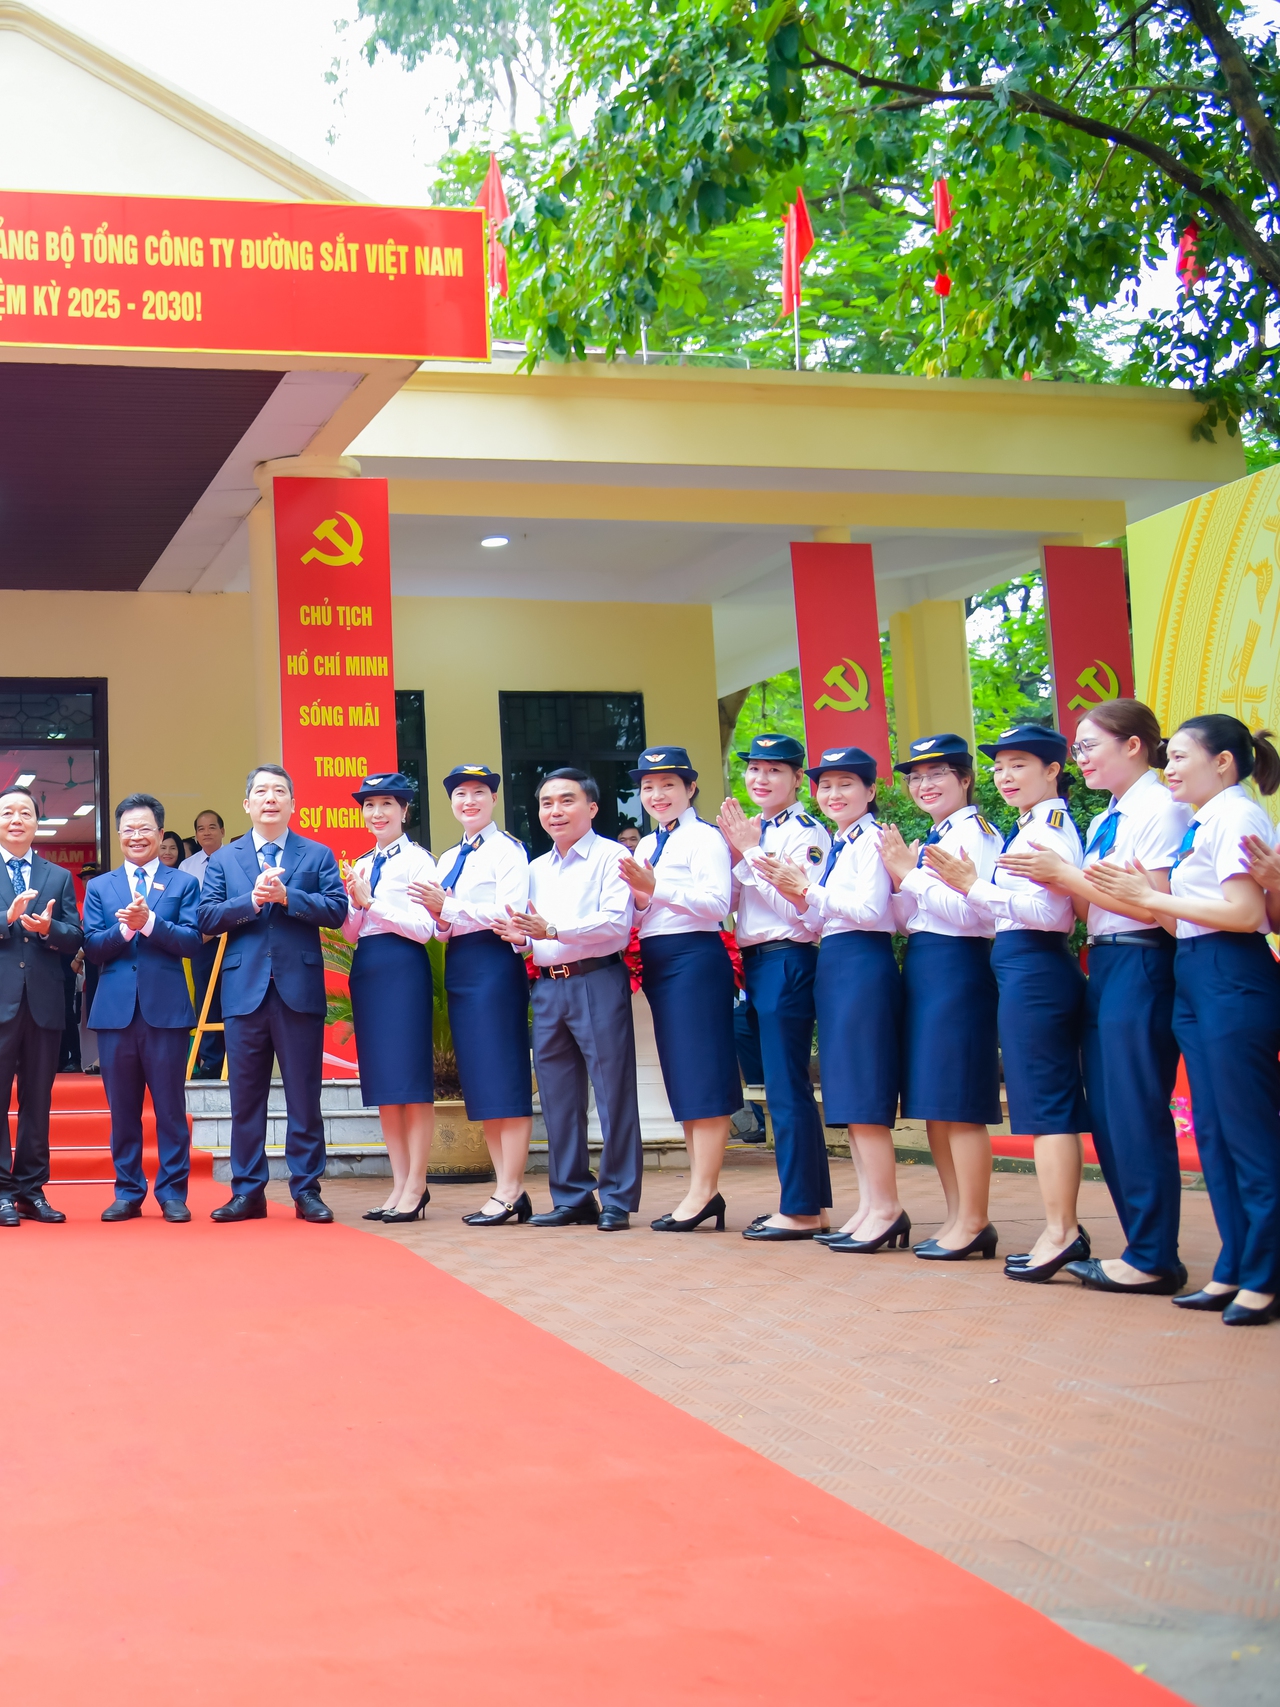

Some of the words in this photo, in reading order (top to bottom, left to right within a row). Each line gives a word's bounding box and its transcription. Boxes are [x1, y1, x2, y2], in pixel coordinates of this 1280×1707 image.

[46, 226, 74, 268] BỘ
[81, 222, 138, 264] TỔNG
[145, 230, 203, 267] CÔNG
[210, 238, 234, 267] TY
[241, 237, 313, 270] ĐƯỜNG
[320, 233, 359, 272] SẮT
[365, 239, 408, 280] VIỆT
[415, 246, 463, 276] NAM
[34, 280, 61, 316] KỲ
[68, 288, 120, 318] 2025
[143, 290, 201, 321] 2030!
[300, 598, 332, 626] CHỦ
[337, 606, 372, 630] TỊCH
[288, 649, 308, 675] HỒ
[314, 652, 340, 675] CHÍ
[346, 656, 388, 676] MINH
[300, 699, 343, 726] SỐNG
[349, 703, 379, 726] MÃI
[314, 757, 367, 778] TRONG
[300, 806, 323, 832] SỰ
[327, 807, 372, 832] NGHI
